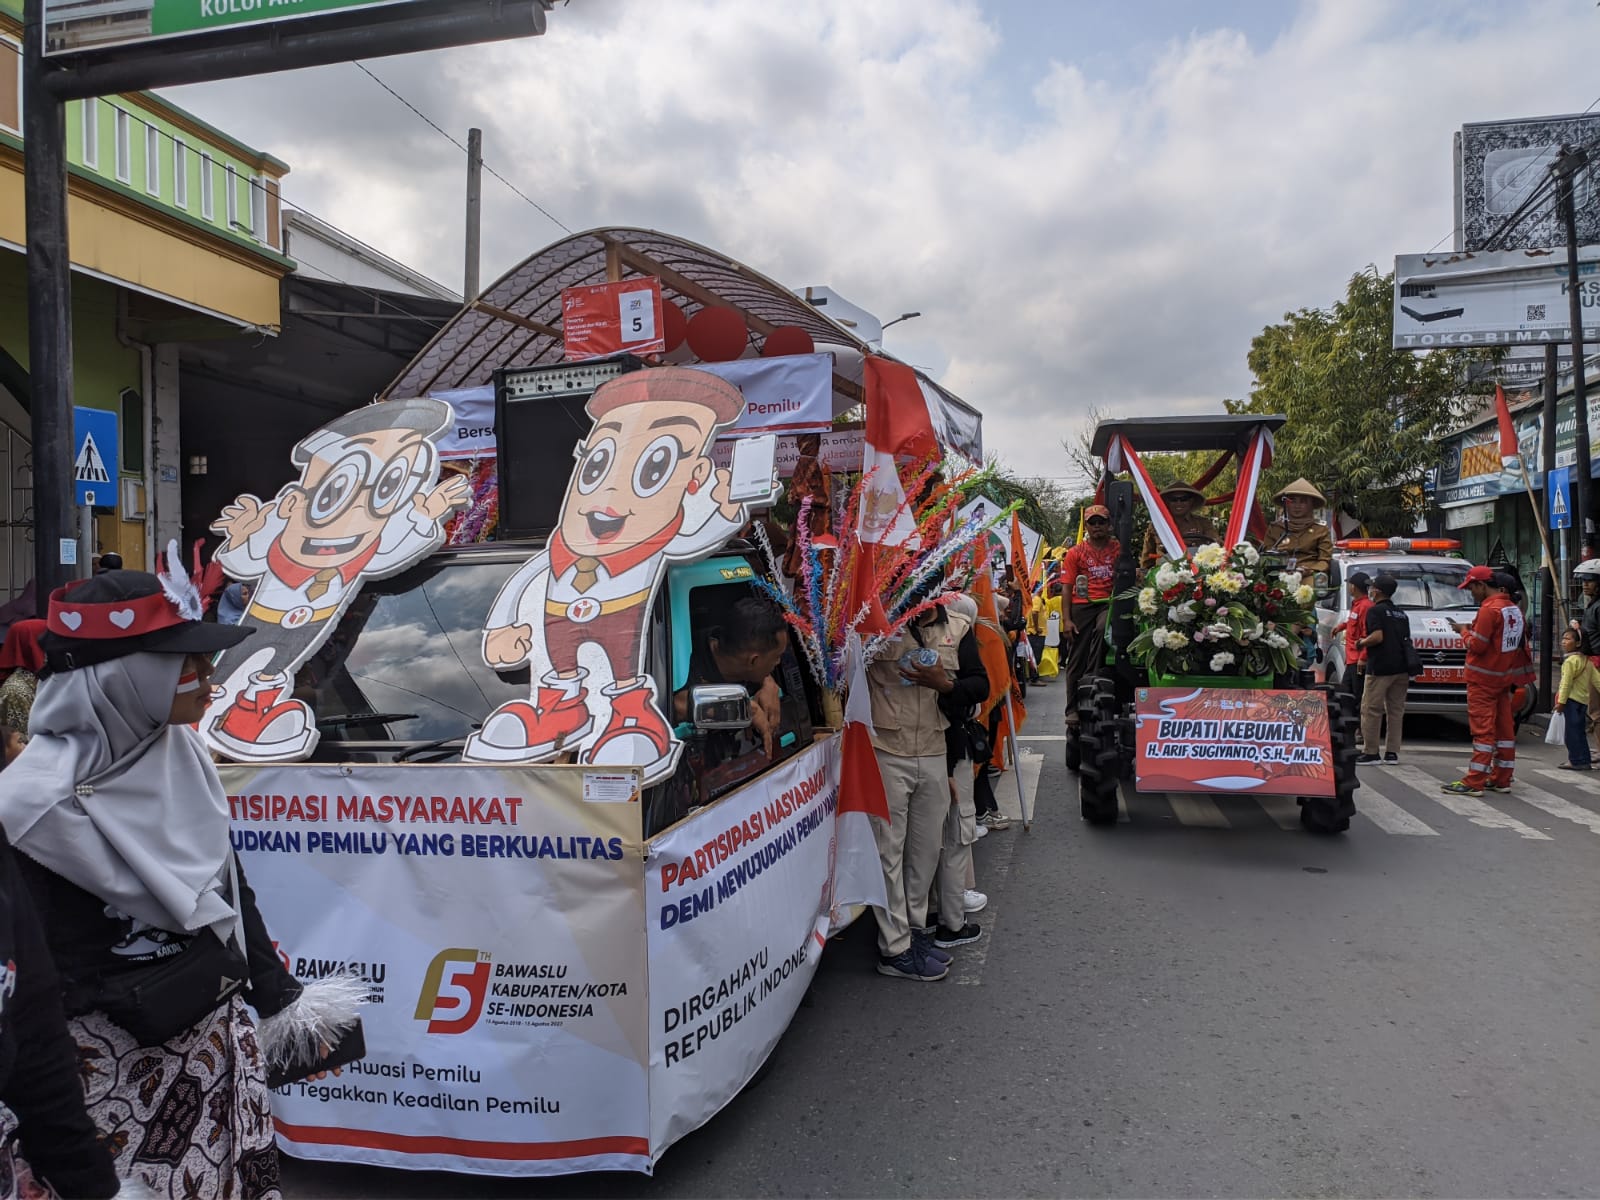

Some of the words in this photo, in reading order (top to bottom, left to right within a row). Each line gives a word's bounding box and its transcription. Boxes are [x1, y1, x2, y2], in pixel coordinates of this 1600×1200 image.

[632, 317, 642, 332] 5
[1404, 333, 1473, 346] TOKO
[1485, 330, 1550, 343] BIMA
[747, 398, 801, 415] Pemilu
[1158, 720, 1218, 740] BUPATI
[1222, 721, 1305, 742] KEBUMEN
[1147, 743, 1160, 757] H.
[1162, 744, 1190, 757] ARIF
[1191, 744, 1260, 761] SUGIYANTO,
[1262, 747, 1290, 763] S.H.,
[1293, 748, 1322, 763] M.H.
[226, 795, 329, 822] TISIPASI
[336, 795, 523, 826] MASYARAKAT
[660, 811, 766, 893] PARTISIPASI
[763, 765, 827, 830] MASYARAKAT
[307, 831, 387, 855] PEMILU
[391, 832, 455, 857] YANG
[461, 833, 624, 861] BERKUALITAS
[660, 886, 714, 931] DEMI
[716, 827, 797, 904] MEWUJUDKAN
[796, 803, 824, 843] PEMILU
[480, 951, 492, 961] TH
[295, 957, 386, 984] BAWASLU
[494, 963, 568, 979] BAWASLU
[491, 982, 629, 1000] KABUPATEN/KOTA
[663, 946, 770, 1034] DIRGAHAYU
[486, 1002, 594, 1018] SE-INDONESIA
[664, 989, 758, 1069] REPUBLIK
[759, 938, 809, 1003] INDONE
[349, 1060, 406, 1079] Awasi
[412, 1062, 481, 1083] Pemilu
[299, 1081, 388, 1105] Tegakkan
[393, 1090, 480, 1112] Keadilan
[486, 1096, 560, 1114] Pemilu
